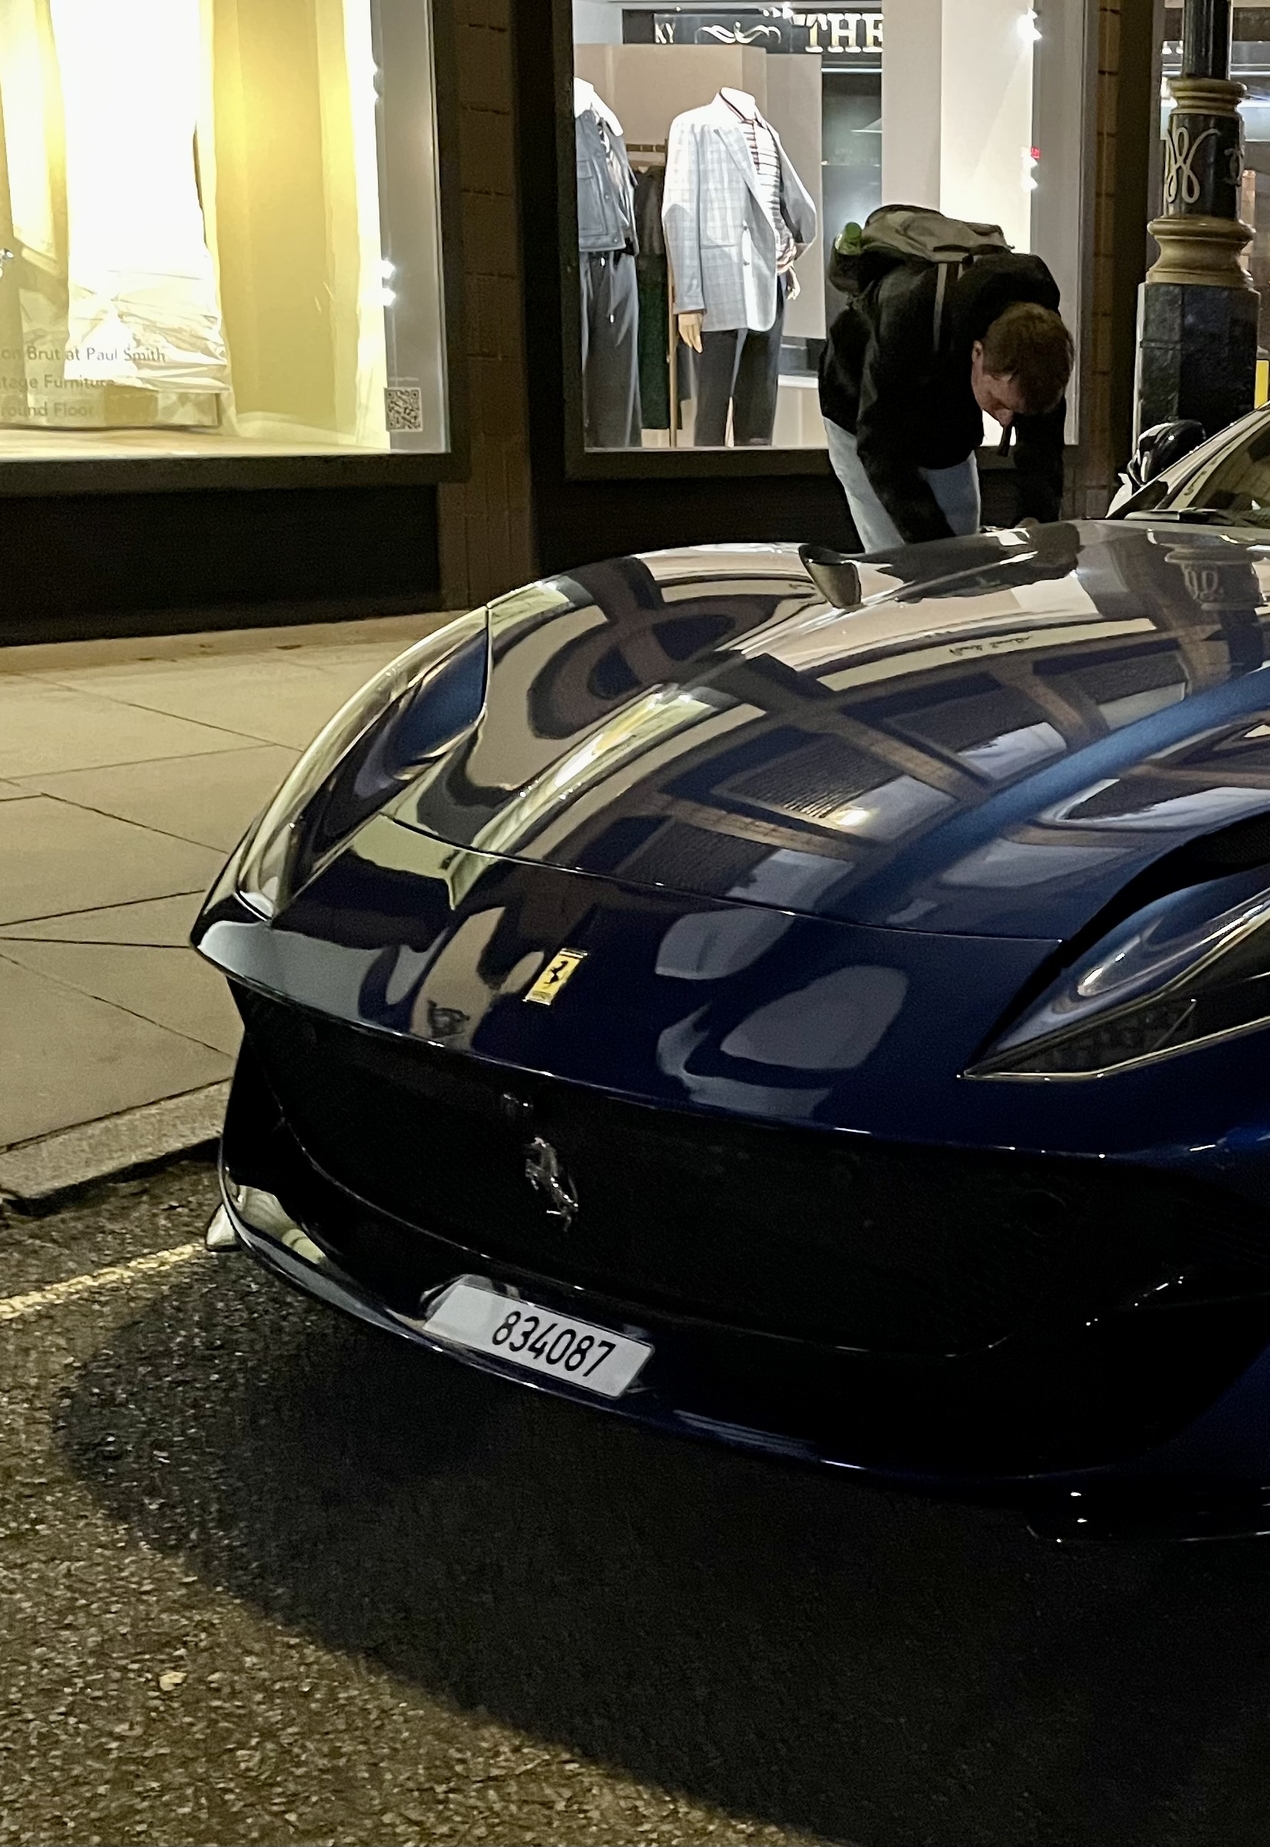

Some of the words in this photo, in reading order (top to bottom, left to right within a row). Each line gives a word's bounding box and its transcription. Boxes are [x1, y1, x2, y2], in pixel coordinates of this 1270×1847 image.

[803, 12, 884, 53] THE
[26, 345, 62, 361] Brut
[65, 345, 81, 361] at
[86, 346, 118, 361] Paul
[123, 347, 166, 363] Smith
[44, 373, 115, 390] Furniture
[53, 401, 94, 417] Floor
[491, 1310, 617, 1378] 834087
